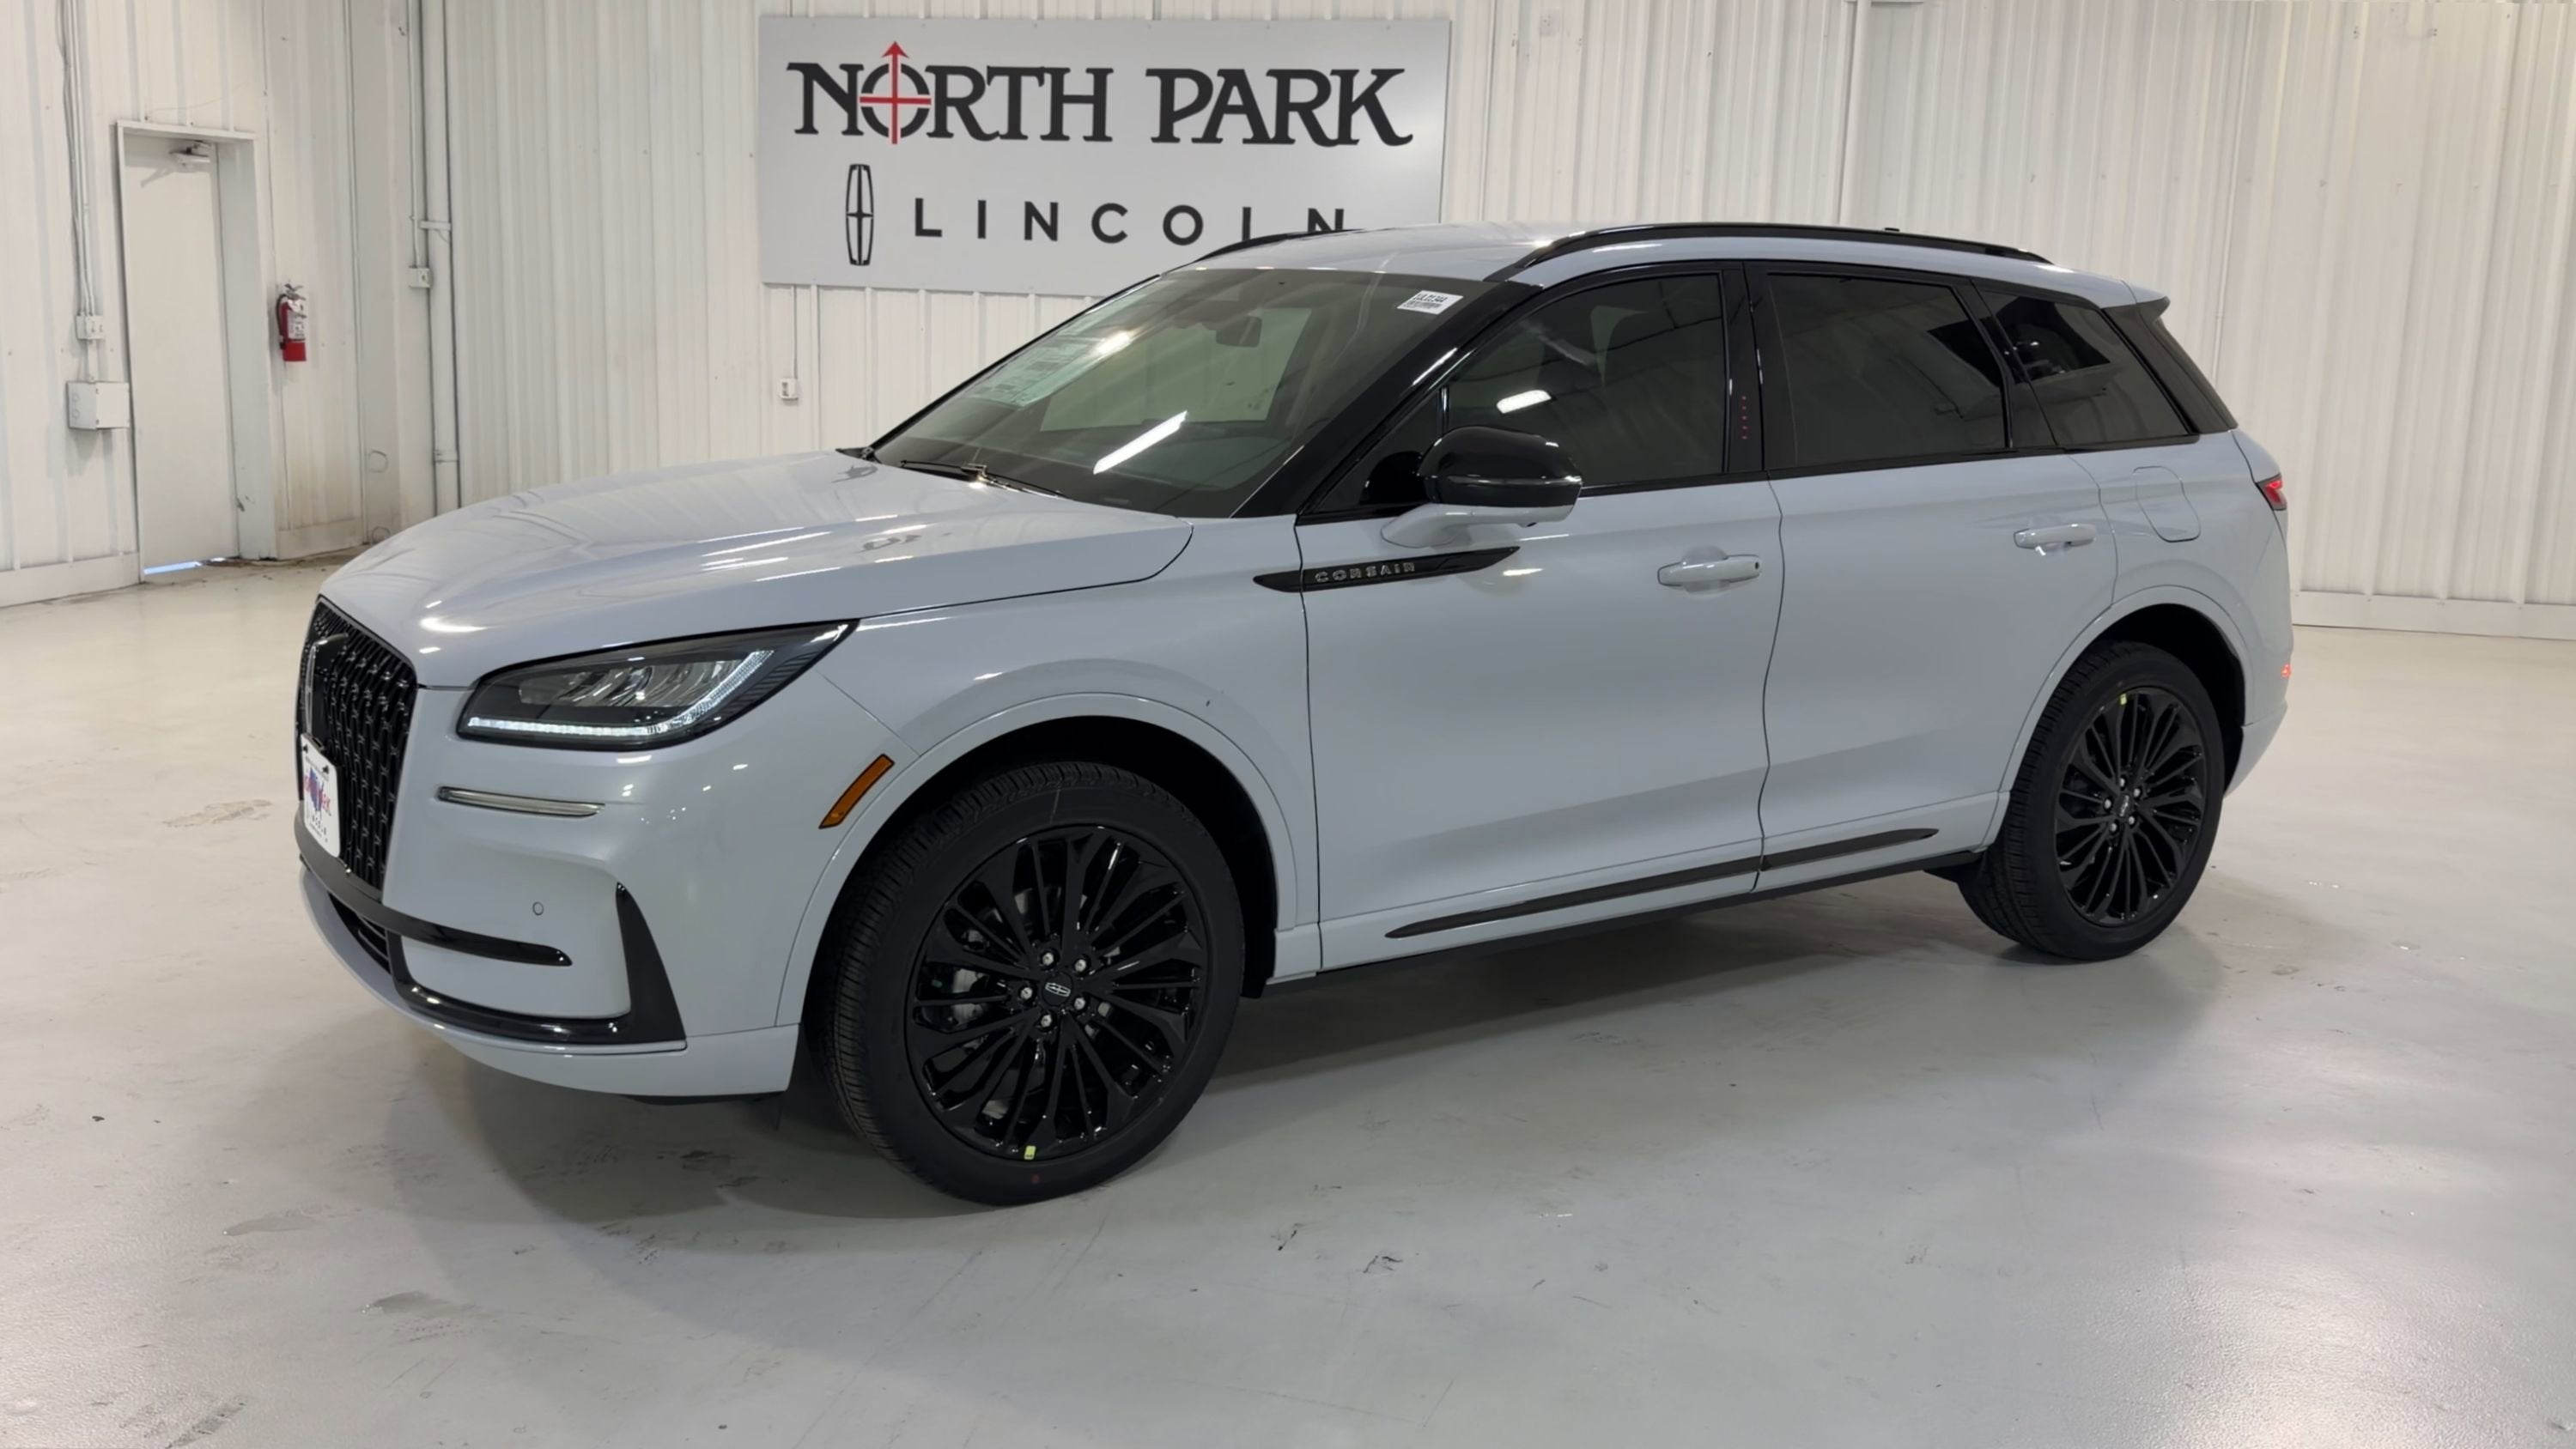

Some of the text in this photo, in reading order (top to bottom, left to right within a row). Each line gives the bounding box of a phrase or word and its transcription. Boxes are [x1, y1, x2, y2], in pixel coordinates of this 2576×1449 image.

[786, 61, 1413, 147] NORTH PARK
[1315, 561, 1415, 583] CORSAIR
